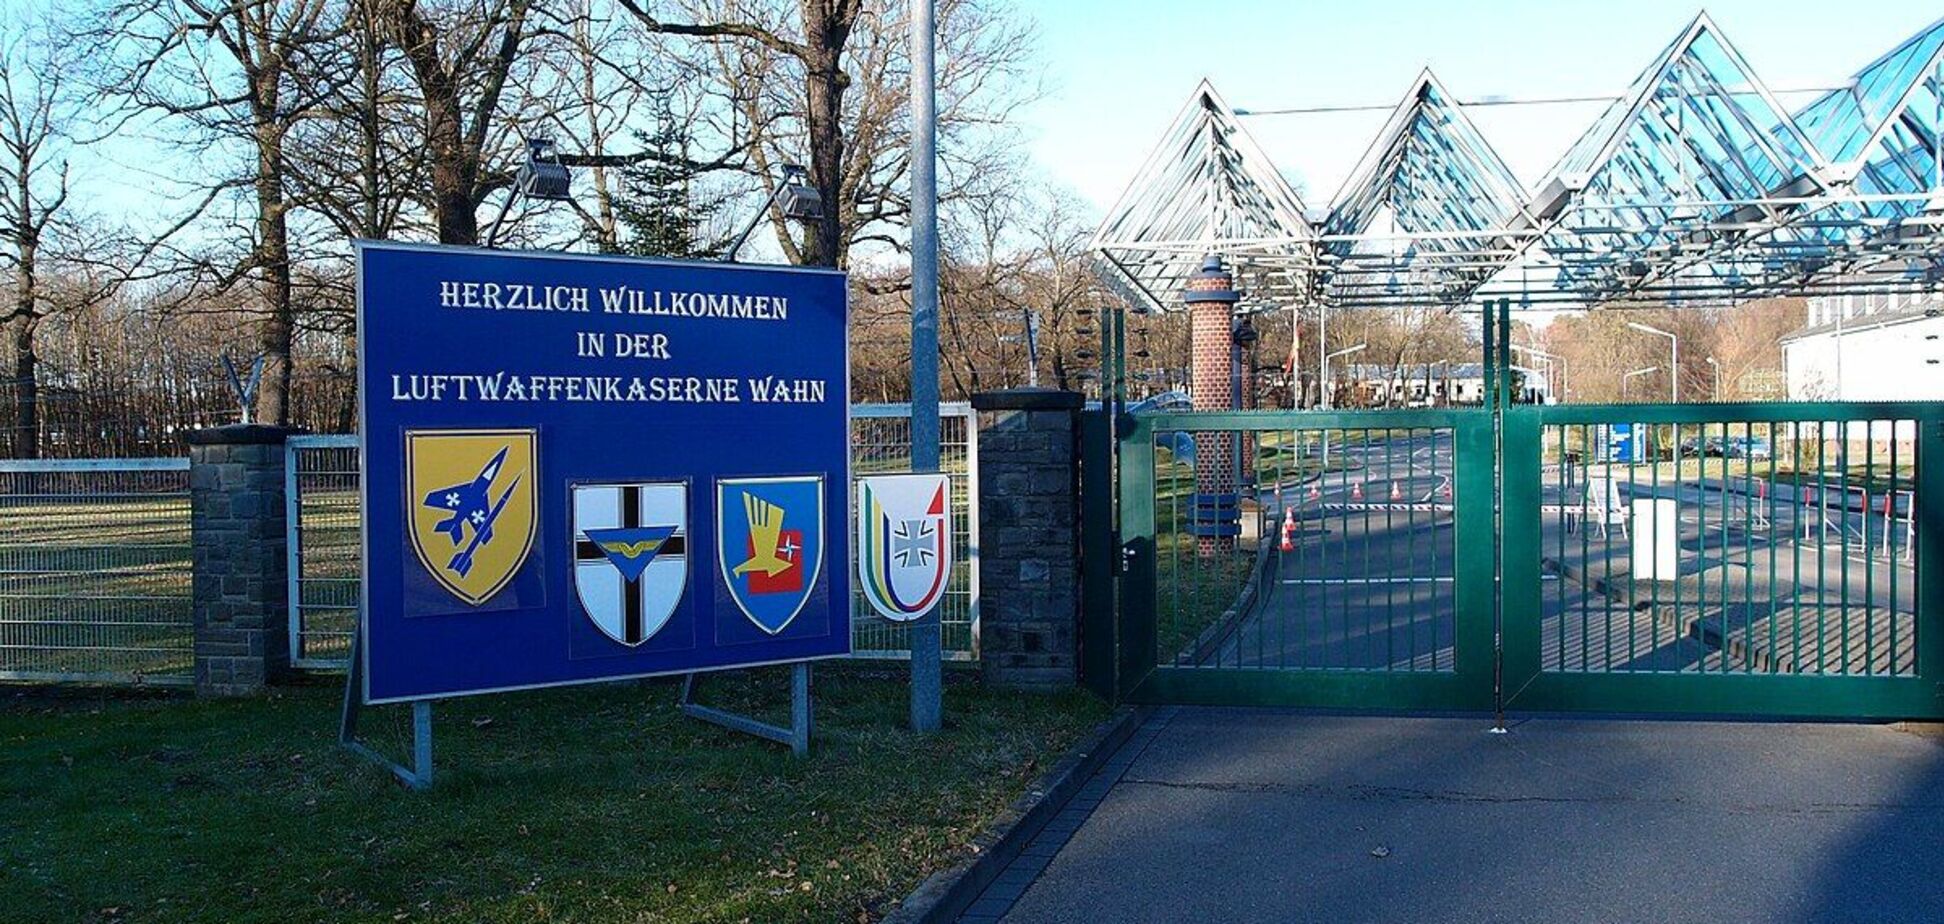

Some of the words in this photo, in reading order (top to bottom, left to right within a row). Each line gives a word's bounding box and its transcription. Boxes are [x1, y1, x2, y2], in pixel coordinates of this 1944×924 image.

[440, 282, 589, 312] HERZLICH
[600, 286, 788, 319] WILLKOMMEN
[578, 332, 605, 357] IN
[615, 333, 671, 359] DER
[392, 372, 739, 402] LUFTWAFFENKASERNE
[749, 375, 825, 403] WAHN
